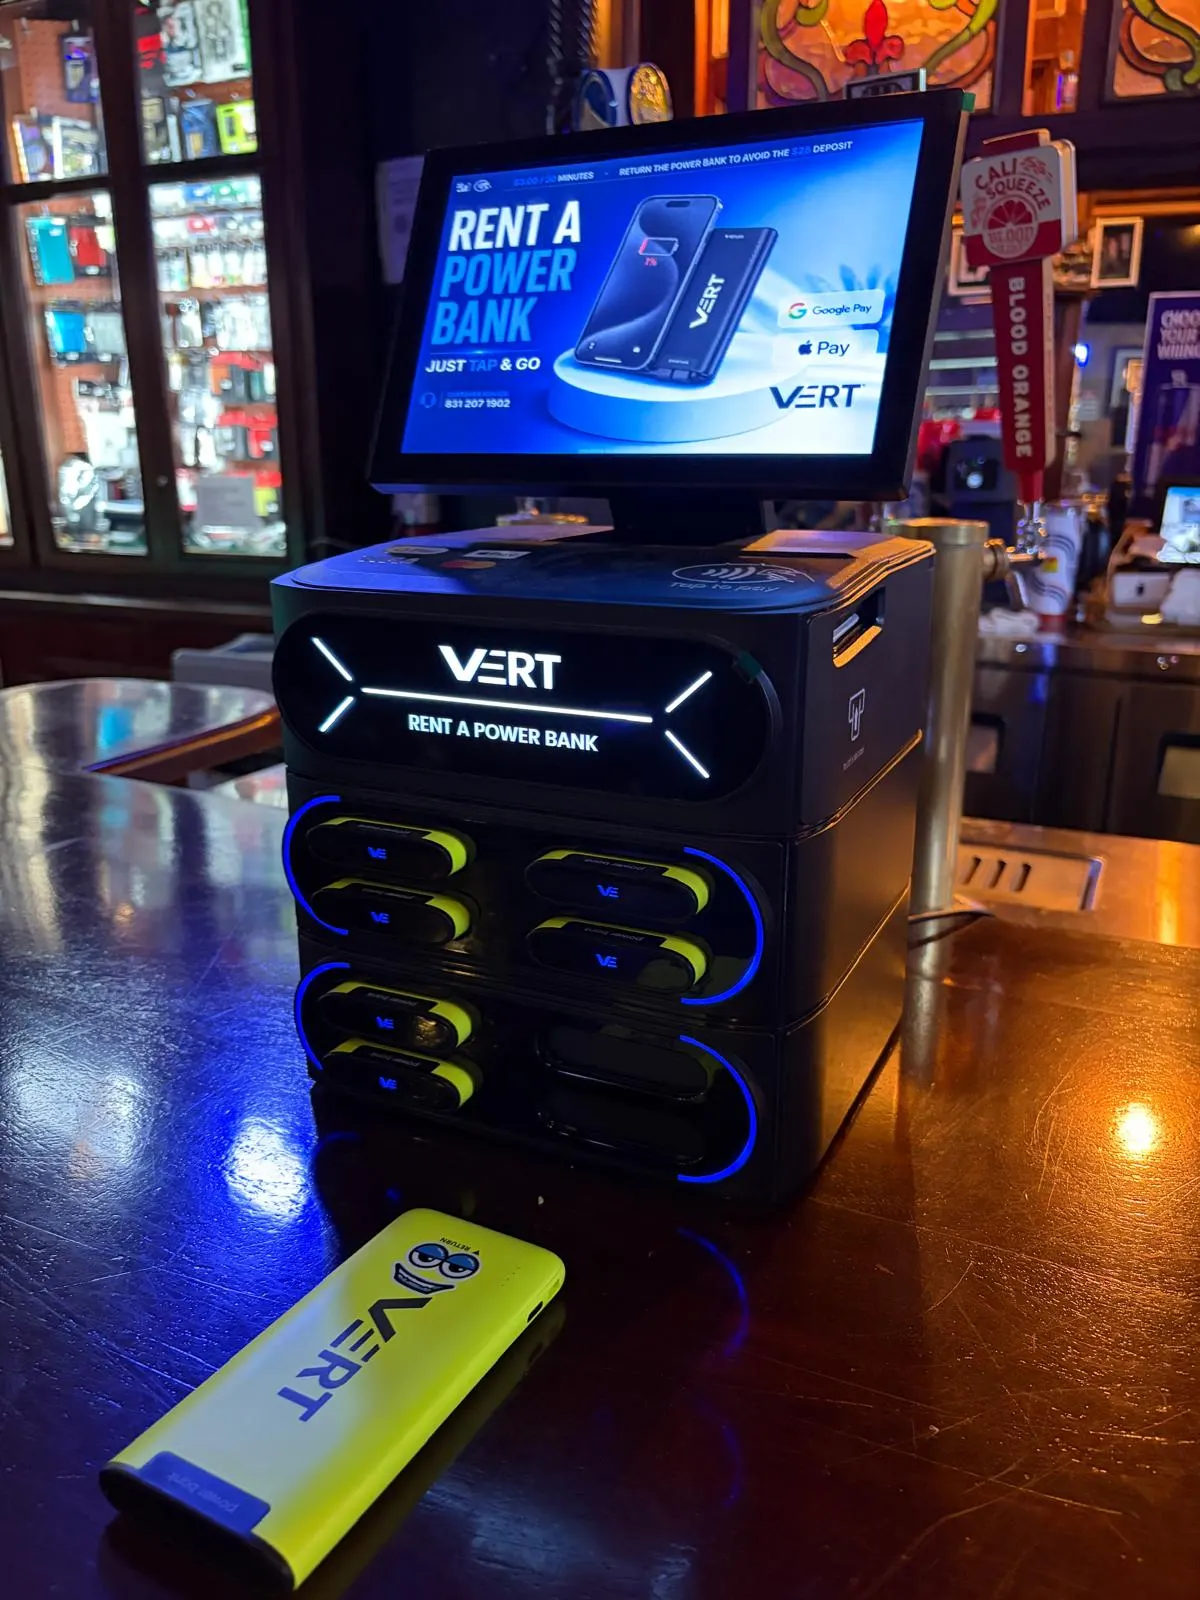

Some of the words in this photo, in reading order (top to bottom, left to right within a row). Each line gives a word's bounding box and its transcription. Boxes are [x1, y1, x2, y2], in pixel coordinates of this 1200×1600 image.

[619, 165, 652, 176] RETURN
[653, 163, 670, 173] THE
[671, 159, 701, 171] POWER
[703, 156, 728, 168] BANK
[729, 153, 741, 164] TO
[742, 151, 770, 163] AVOID
[772, 149, 789, 159] THE
[813, 141, 853, 153] DEPOSIT
[557, 171, 594, 182] MINUTES
[975, 157, 1017, 190] CALI
[985, 177, 1052, 211] SQUEEZE
[448, 202, 550, 252] RENT
[552, 200, 581, 244] A
[439, 247, 577, 298] POWER
[689, 273, 726, 329] VERT
[812, 303, 851, 316] Google
[853, 303, 872, 314] Pay
[431, 297, 538, 345] BANK
[1008, 276, 1028, 355] BLOOD
[817, 341, 850, 357] Pay
[425, 358, 467, 373] JUST
[470, 358, 498, 372] TAP
[500, 357, 512, 371] &
[515, 357, 541, 371] GO
[444, 398, 463, 408] 831
[464, 398, 484, 408] 207
[486, 398, 511, 408] 1902
[769, 383, 862, 409] VERT
[1012, 364, 1033, 458] ORANGE
[438, 645, 562, 690] VERT
[408, 713, 453, 735] RENT
[456, 720, 470, 737] A
[474, 723, 540, 745] POWER
[545, 730, 599, 753] BANK
[368, 846, 387, 859] VE
[596, 884, 619, 898] VE
[370, 911, 390, 924] VE
[595, 953, 617, 968] VE
[376, 1016, 395, 1029] VE
[379, 1076, 397, 1090] VE
[439, 1237, 471, 1251] RETURN
[277, 1297, 433, 1423] VERT
